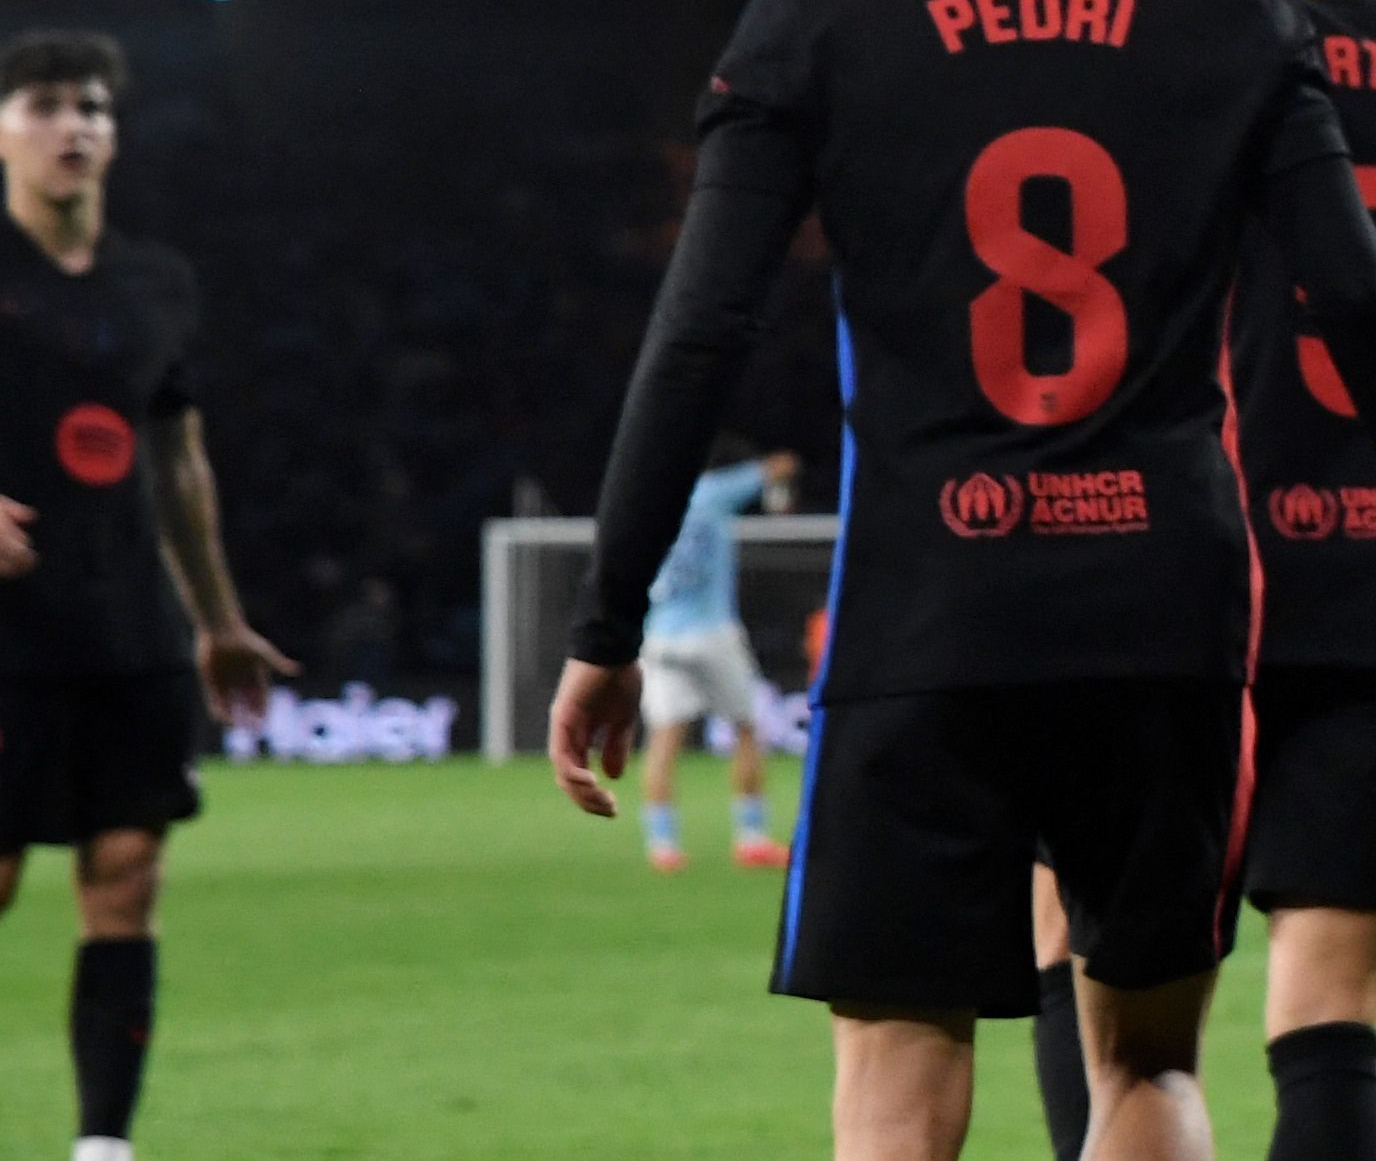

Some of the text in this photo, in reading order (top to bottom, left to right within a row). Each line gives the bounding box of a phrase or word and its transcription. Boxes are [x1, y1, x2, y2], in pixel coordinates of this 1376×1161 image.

[964, 125, 1130, 427] 8
[1028, 470, 1144, 497] UNHCR
[1031, 495, 1148, 523] ACNUR
